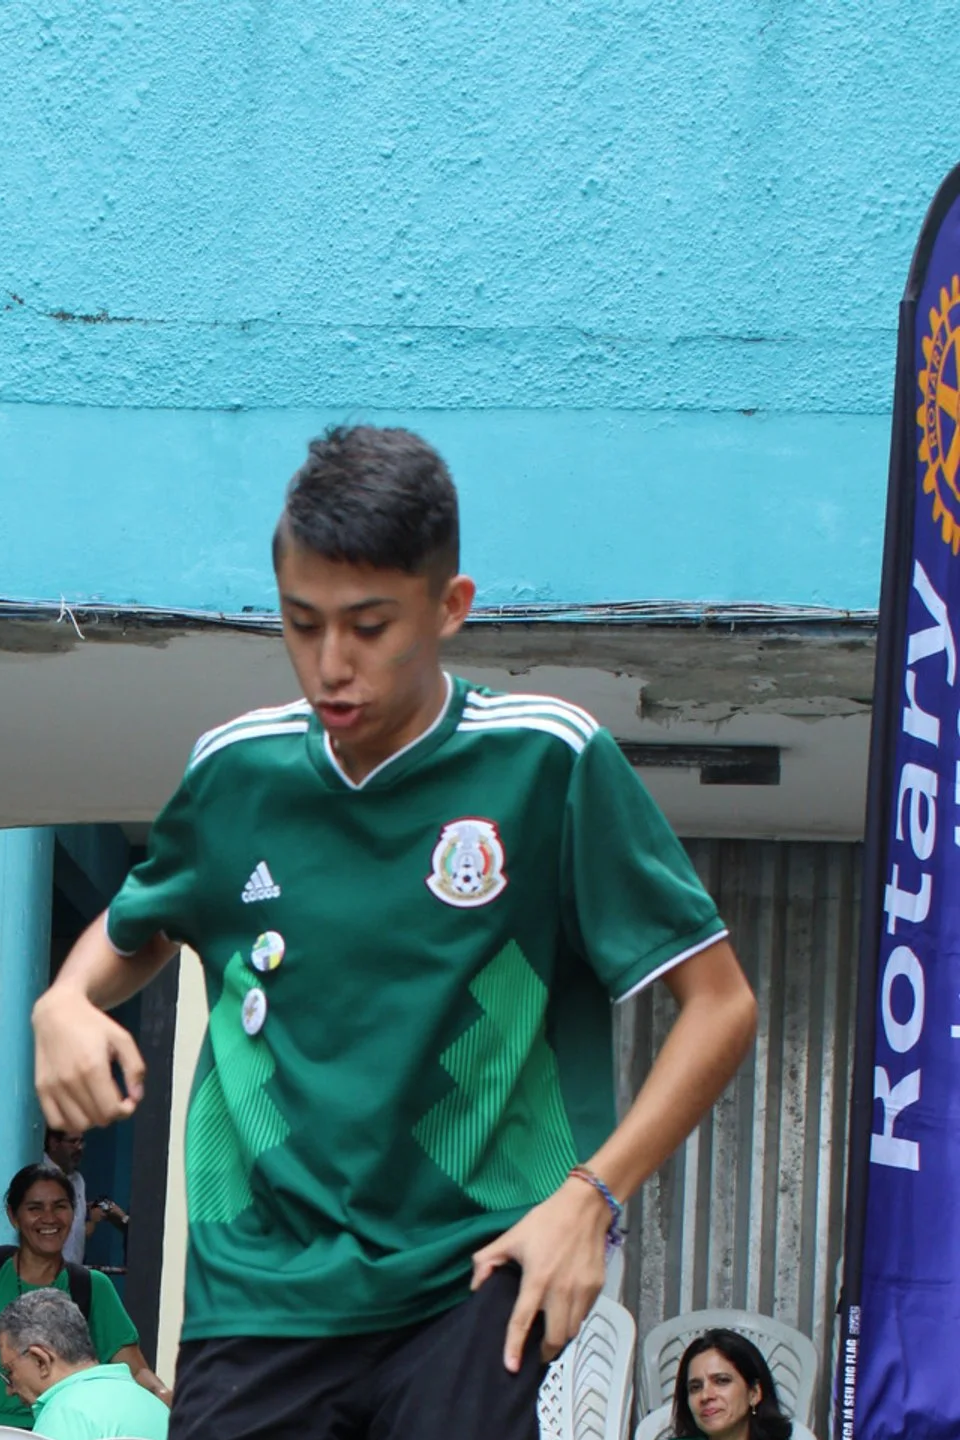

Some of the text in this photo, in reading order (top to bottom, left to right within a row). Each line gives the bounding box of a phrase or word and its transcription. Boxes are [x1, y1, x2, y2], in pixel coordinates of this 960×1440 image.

[928, 332, 943, 447] ROTARY
[870, 559, 957, 1171] Rotary
[845, 1366, 856, 1385] BIG
[846, 1339, 857, 1364] FLAG
